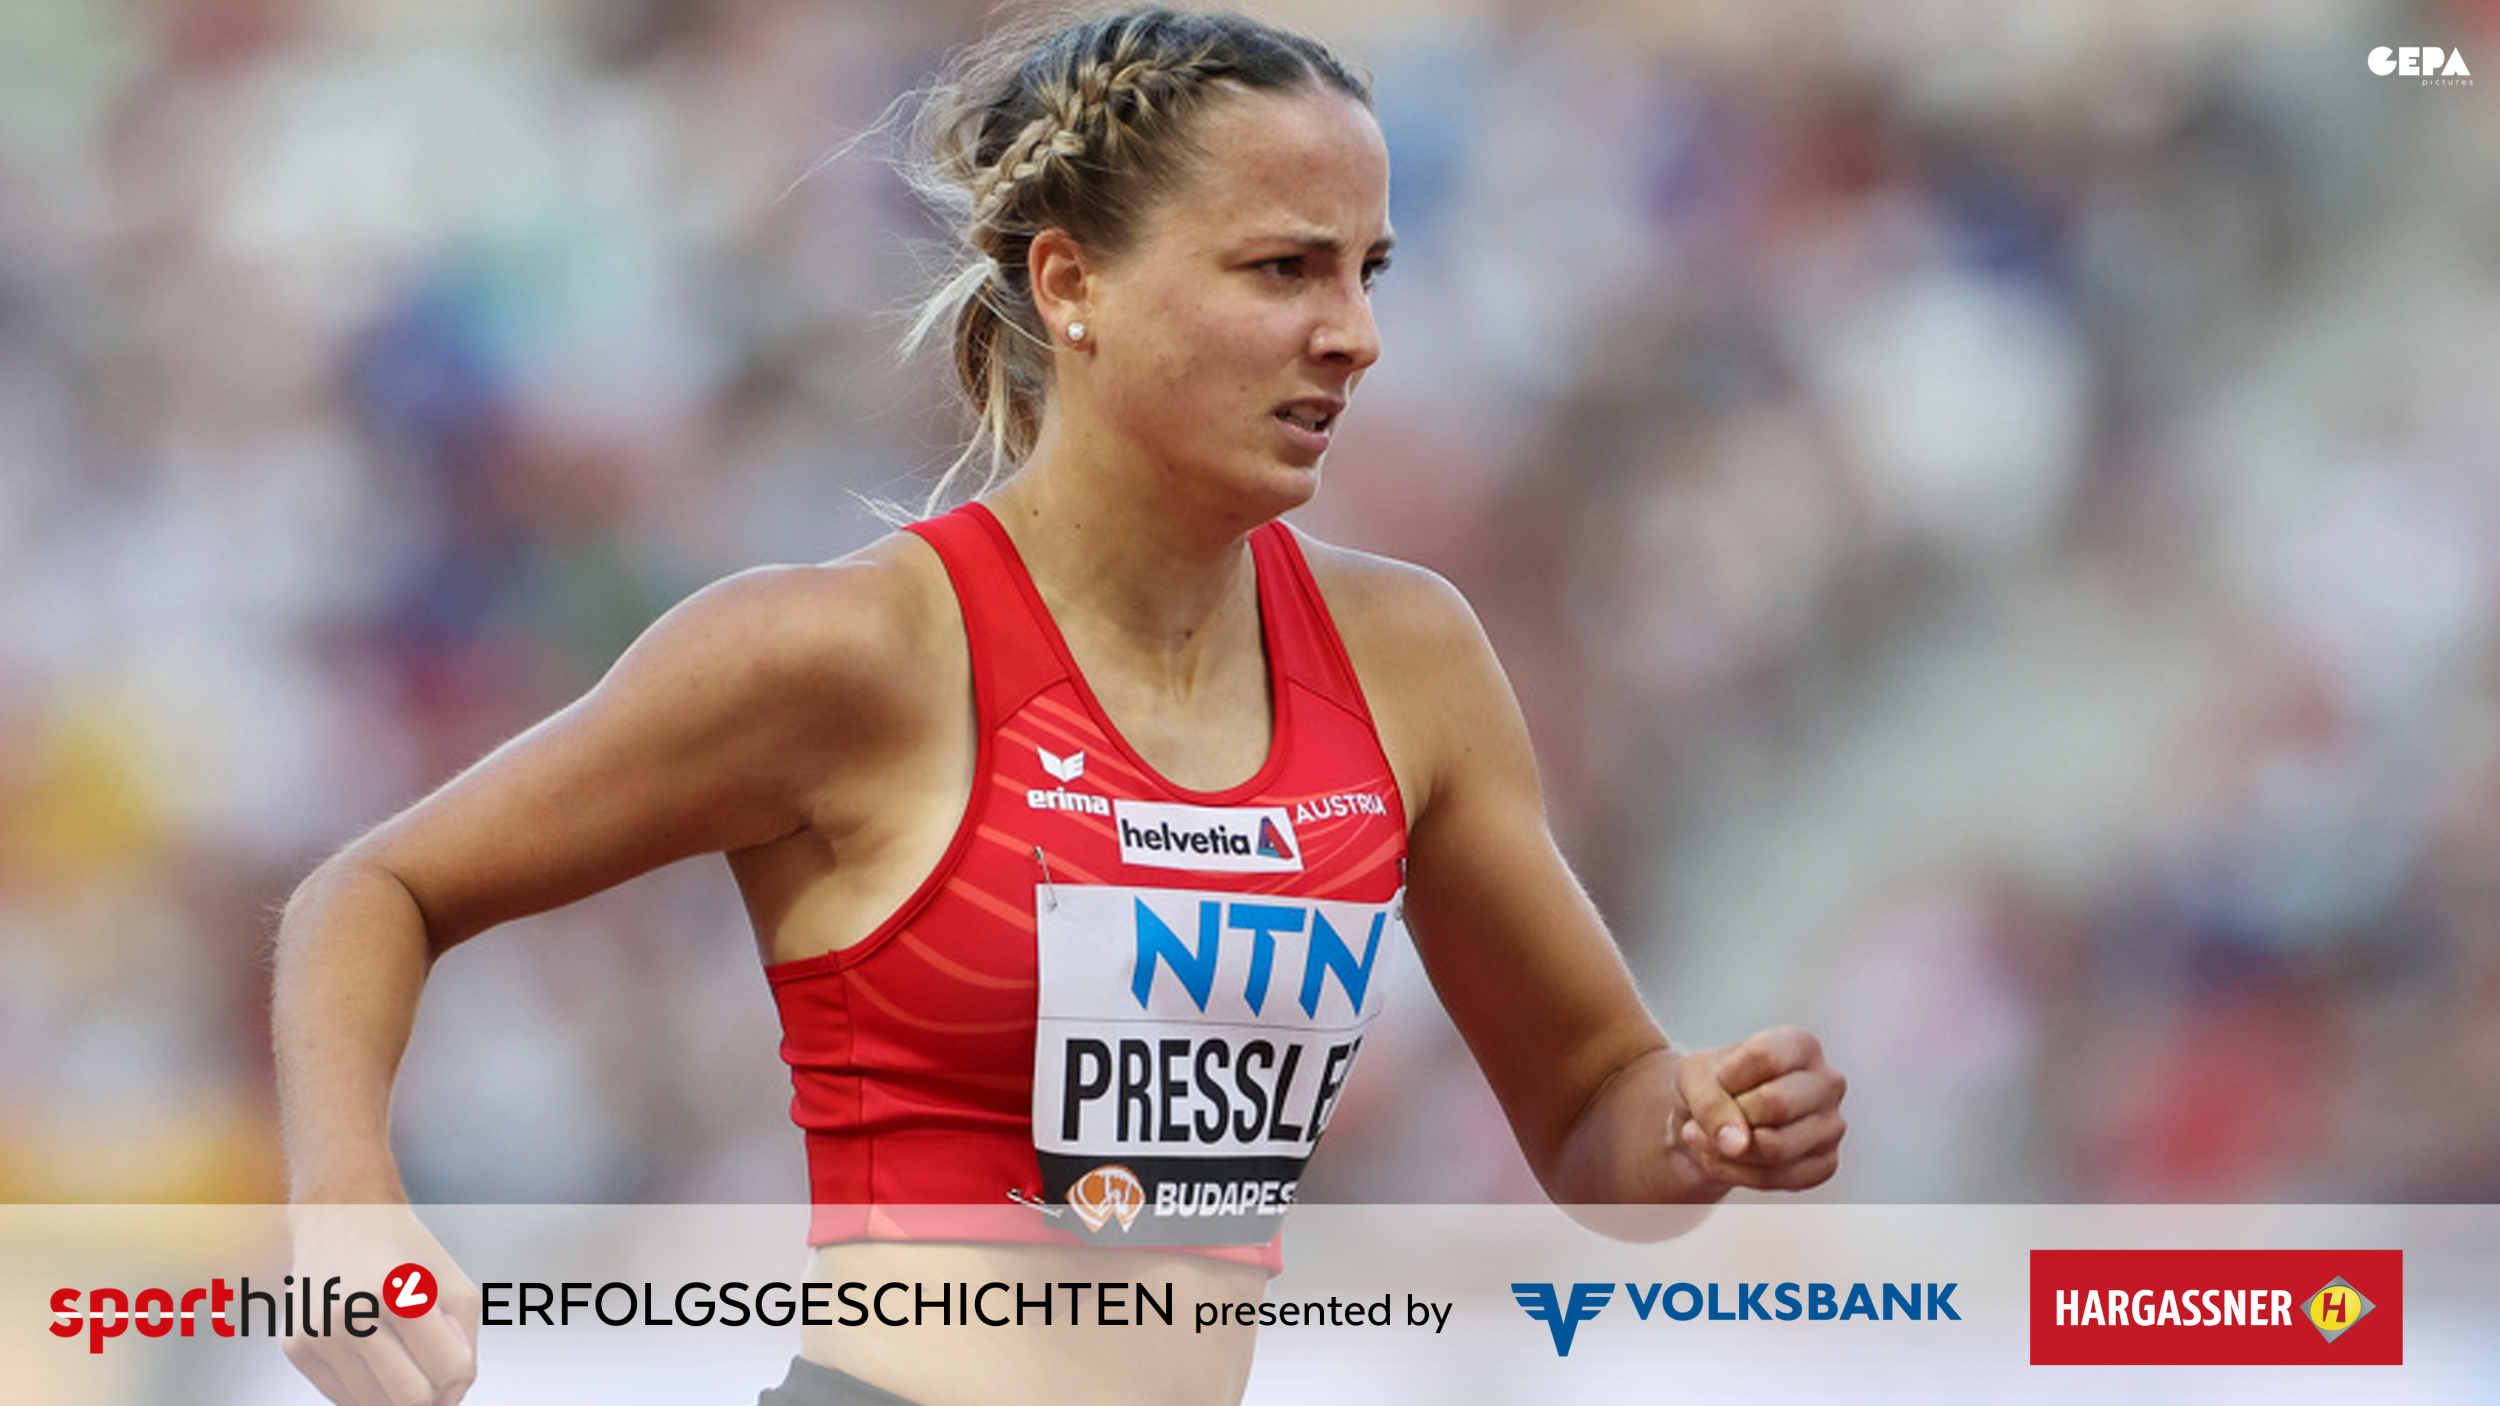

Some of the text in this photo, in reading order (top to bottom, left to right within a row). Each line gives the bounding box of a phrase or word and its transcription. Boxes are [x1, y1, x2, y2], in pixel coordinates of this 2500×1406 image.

[1026, 786, 1111, 816] erima
[1296, 794, 1388, 825] AUSTRIA
[1121, 819, 1251, 856] helvetia
[1131, 895, 1387, 1020] NTN
